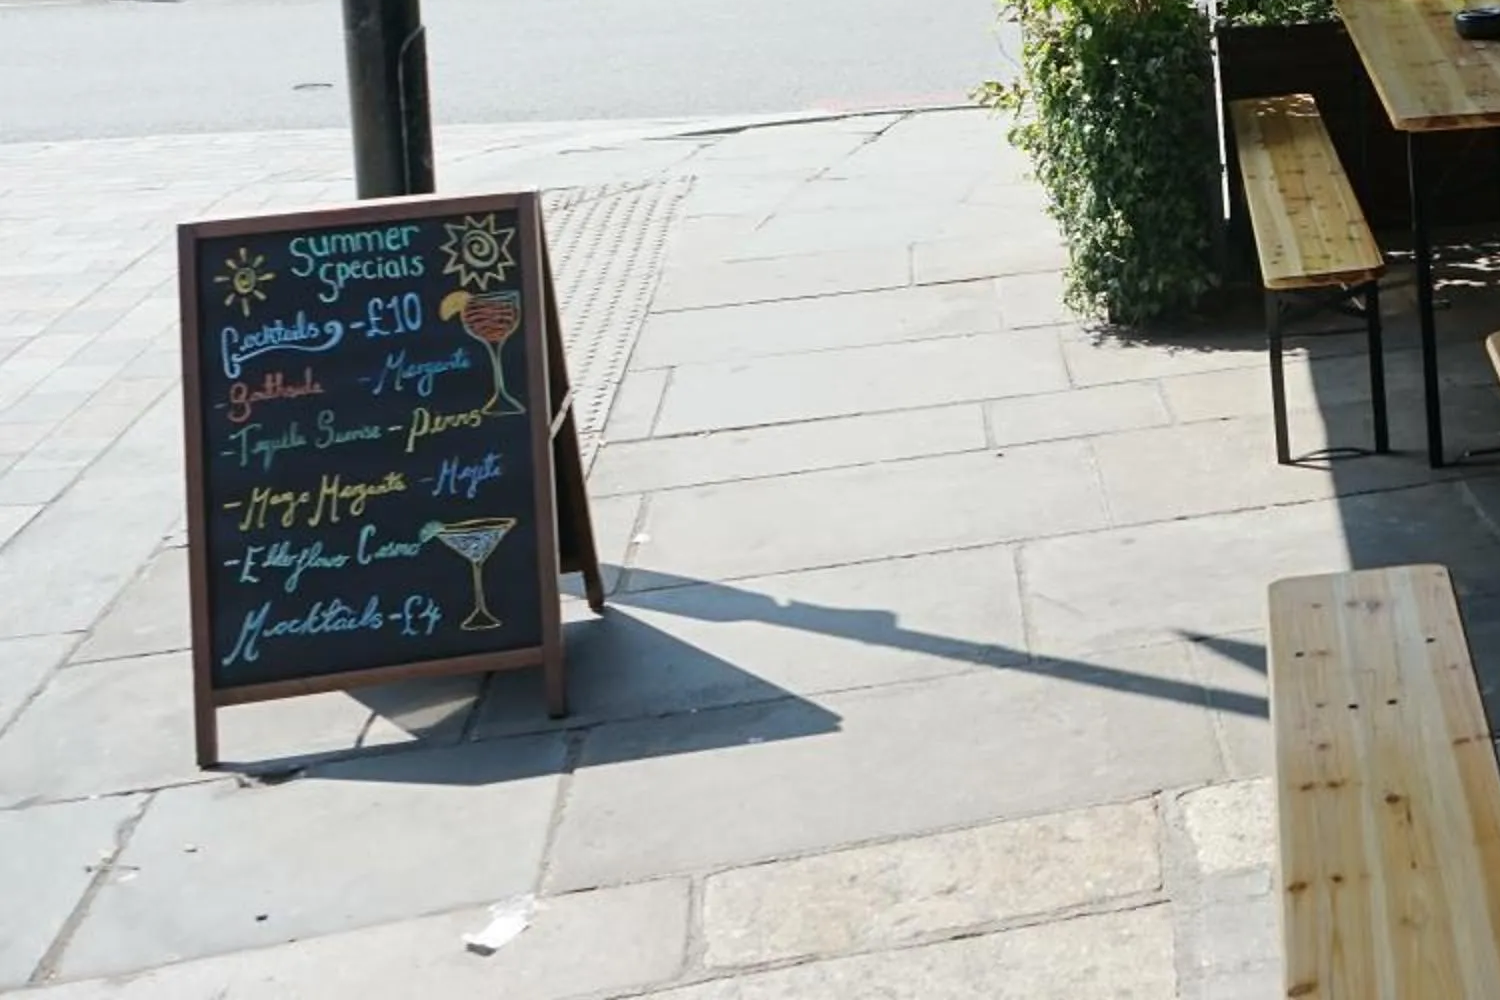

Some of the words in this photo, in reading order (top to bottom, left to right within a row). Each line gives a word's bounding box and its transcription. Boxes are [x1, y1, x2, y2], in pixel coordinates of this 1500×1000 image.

[289, 225, 420, 277] Summer
[318, 254, 425, 303] Specials
[221, 310, 343, 380] Cocktails
[221, 595, 384, 666] Mocktails
